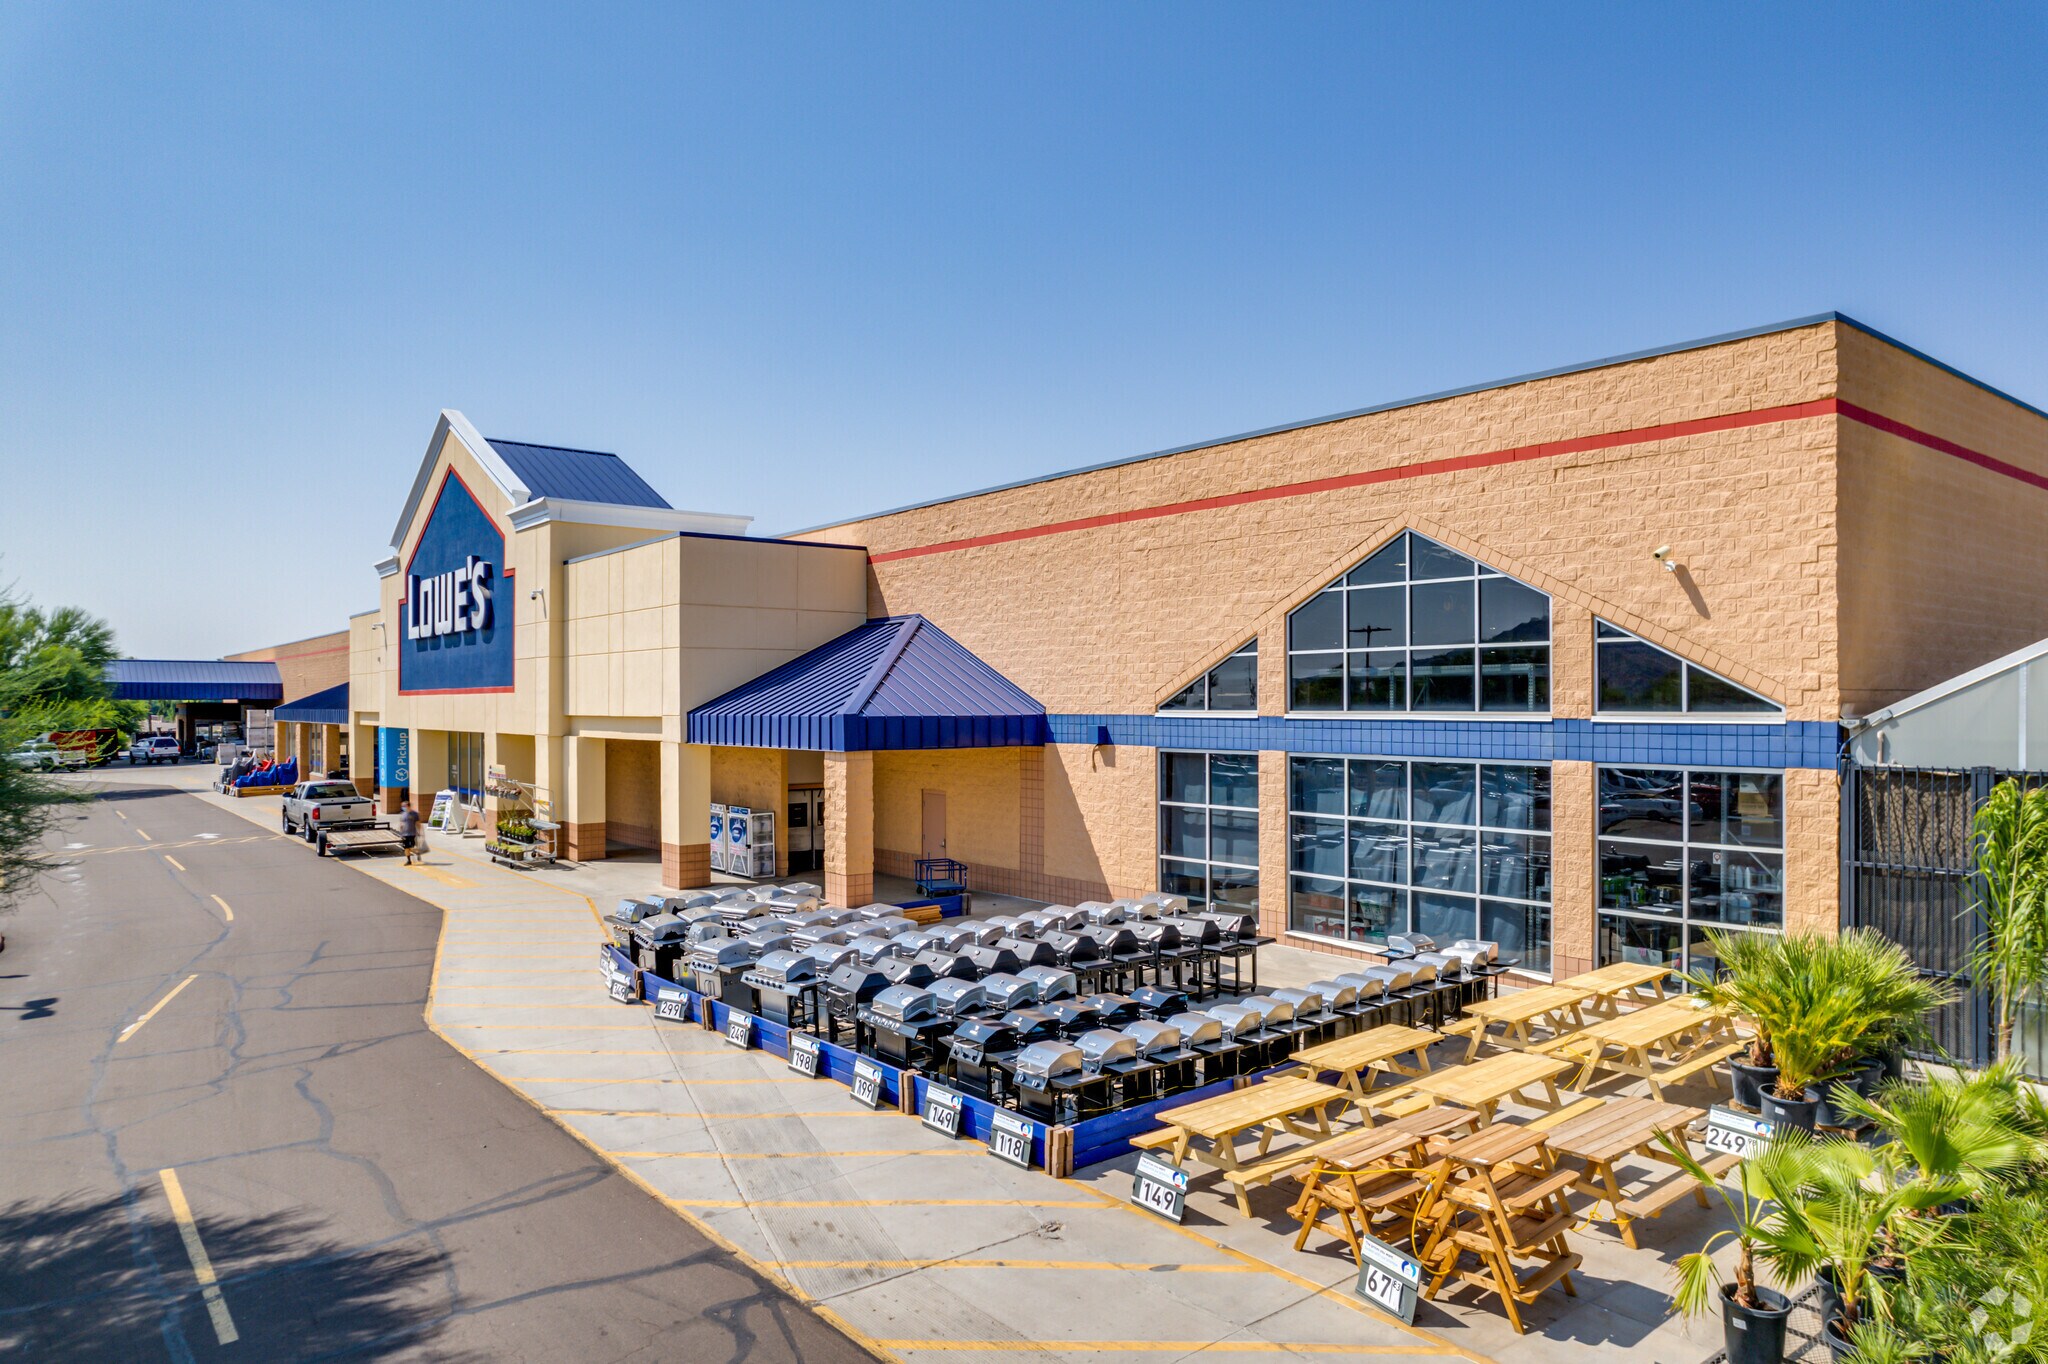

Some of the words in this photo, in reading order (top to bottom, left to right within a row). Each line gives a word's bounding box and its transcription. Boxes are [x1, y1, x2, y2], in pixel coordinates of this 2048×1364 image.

[408, 555, 491, 640] LOWE'S
[397, 732, 408, 766] Pickup
[661, 1001, 680, 1016] 299
[731, 1026, 744, 1043] 249
[796, 1052, 811, 1070] 198
[857, 1079, 874, 1099] 199
[1368, 1269, 1392, 1298] 67
